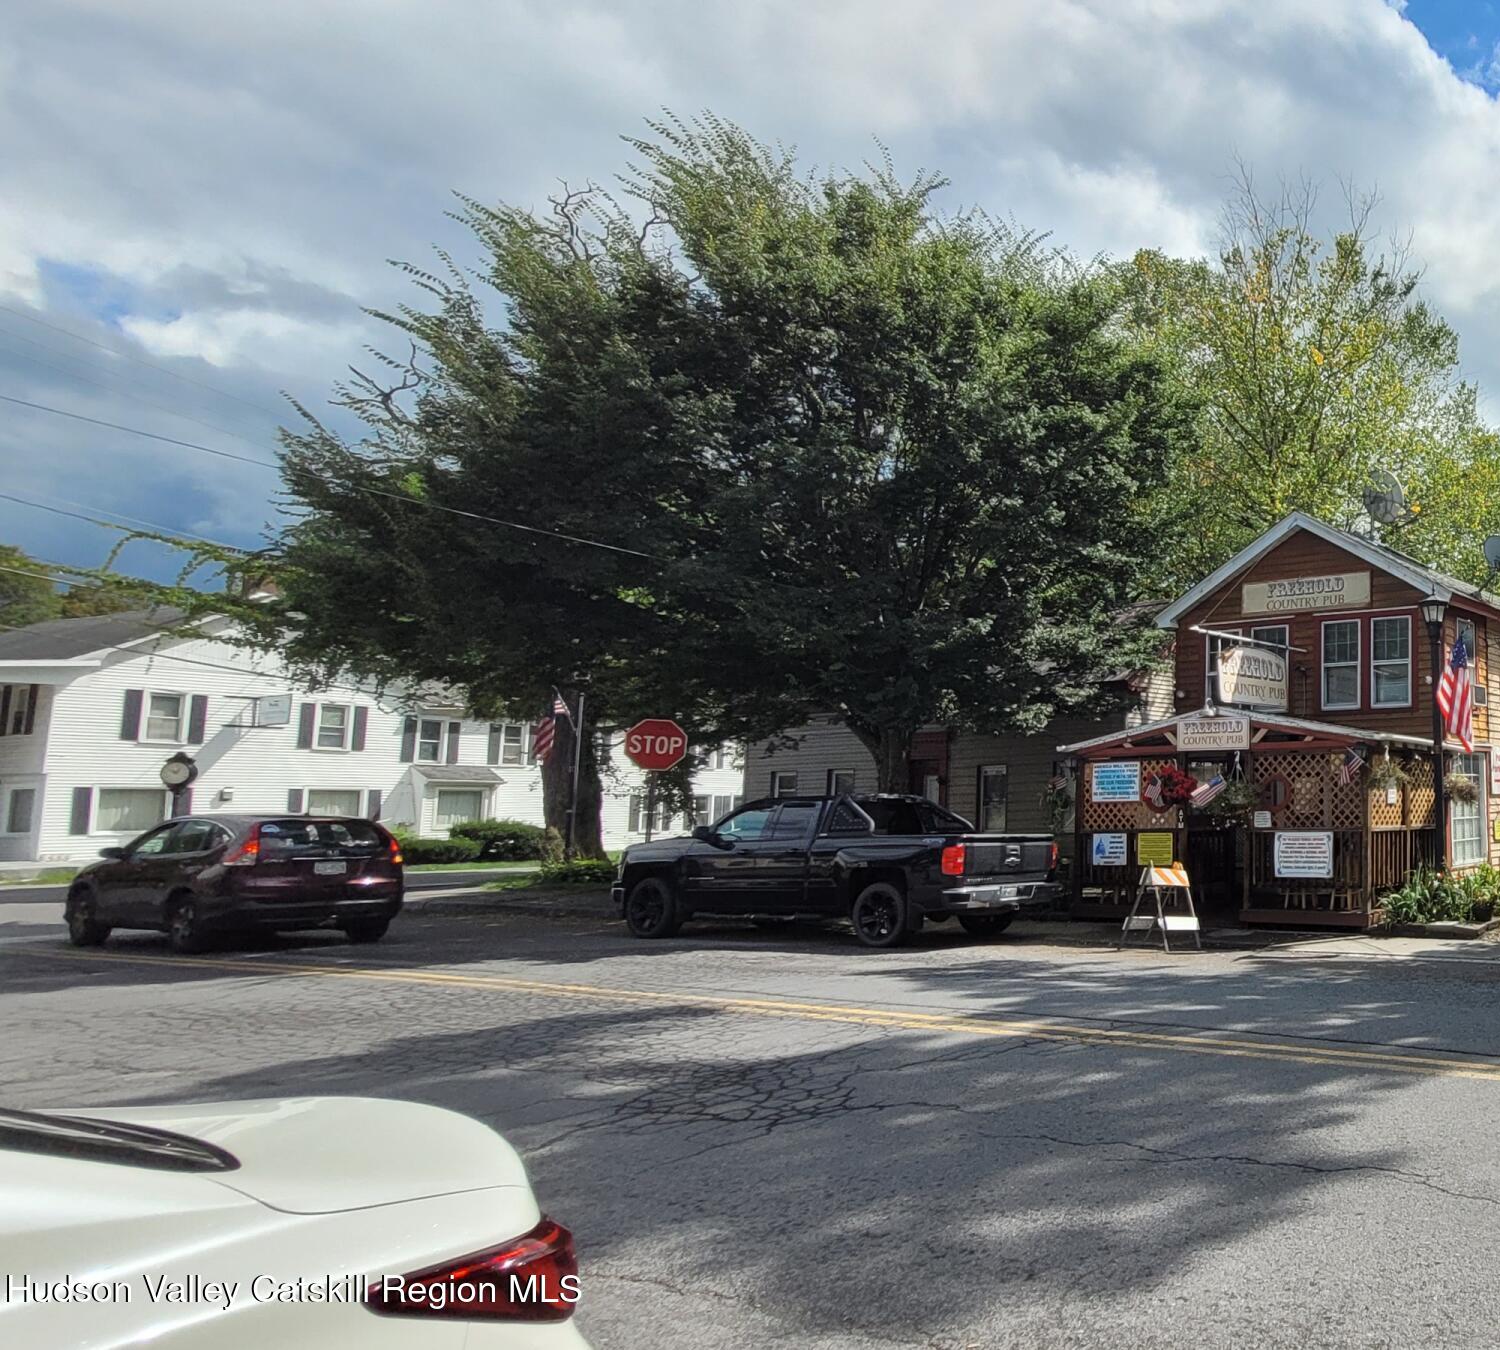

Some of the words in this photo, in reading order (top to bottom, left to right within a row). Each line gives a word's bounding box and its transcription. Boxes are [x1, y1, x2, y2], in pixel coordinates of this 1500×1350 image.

[1267, 577, 1345, 598] FREEHOLD
[1266, 597, 1318, 611] COUNTRY
[1322, 594, 1345, 605] PUB
[1222, 656, 1284, 682] FREEHOLD
[1223, 681, 1266, 701] COUNTRY
[1269, 687, 1286, 700] PUB
[1183, 720, 1243, 734] FREEHOLD
[629, 735, 683, 755] STOP
[1183, 735, 1223, 746] COUNTRY
[1226, 735, 1243, 744] PUB
